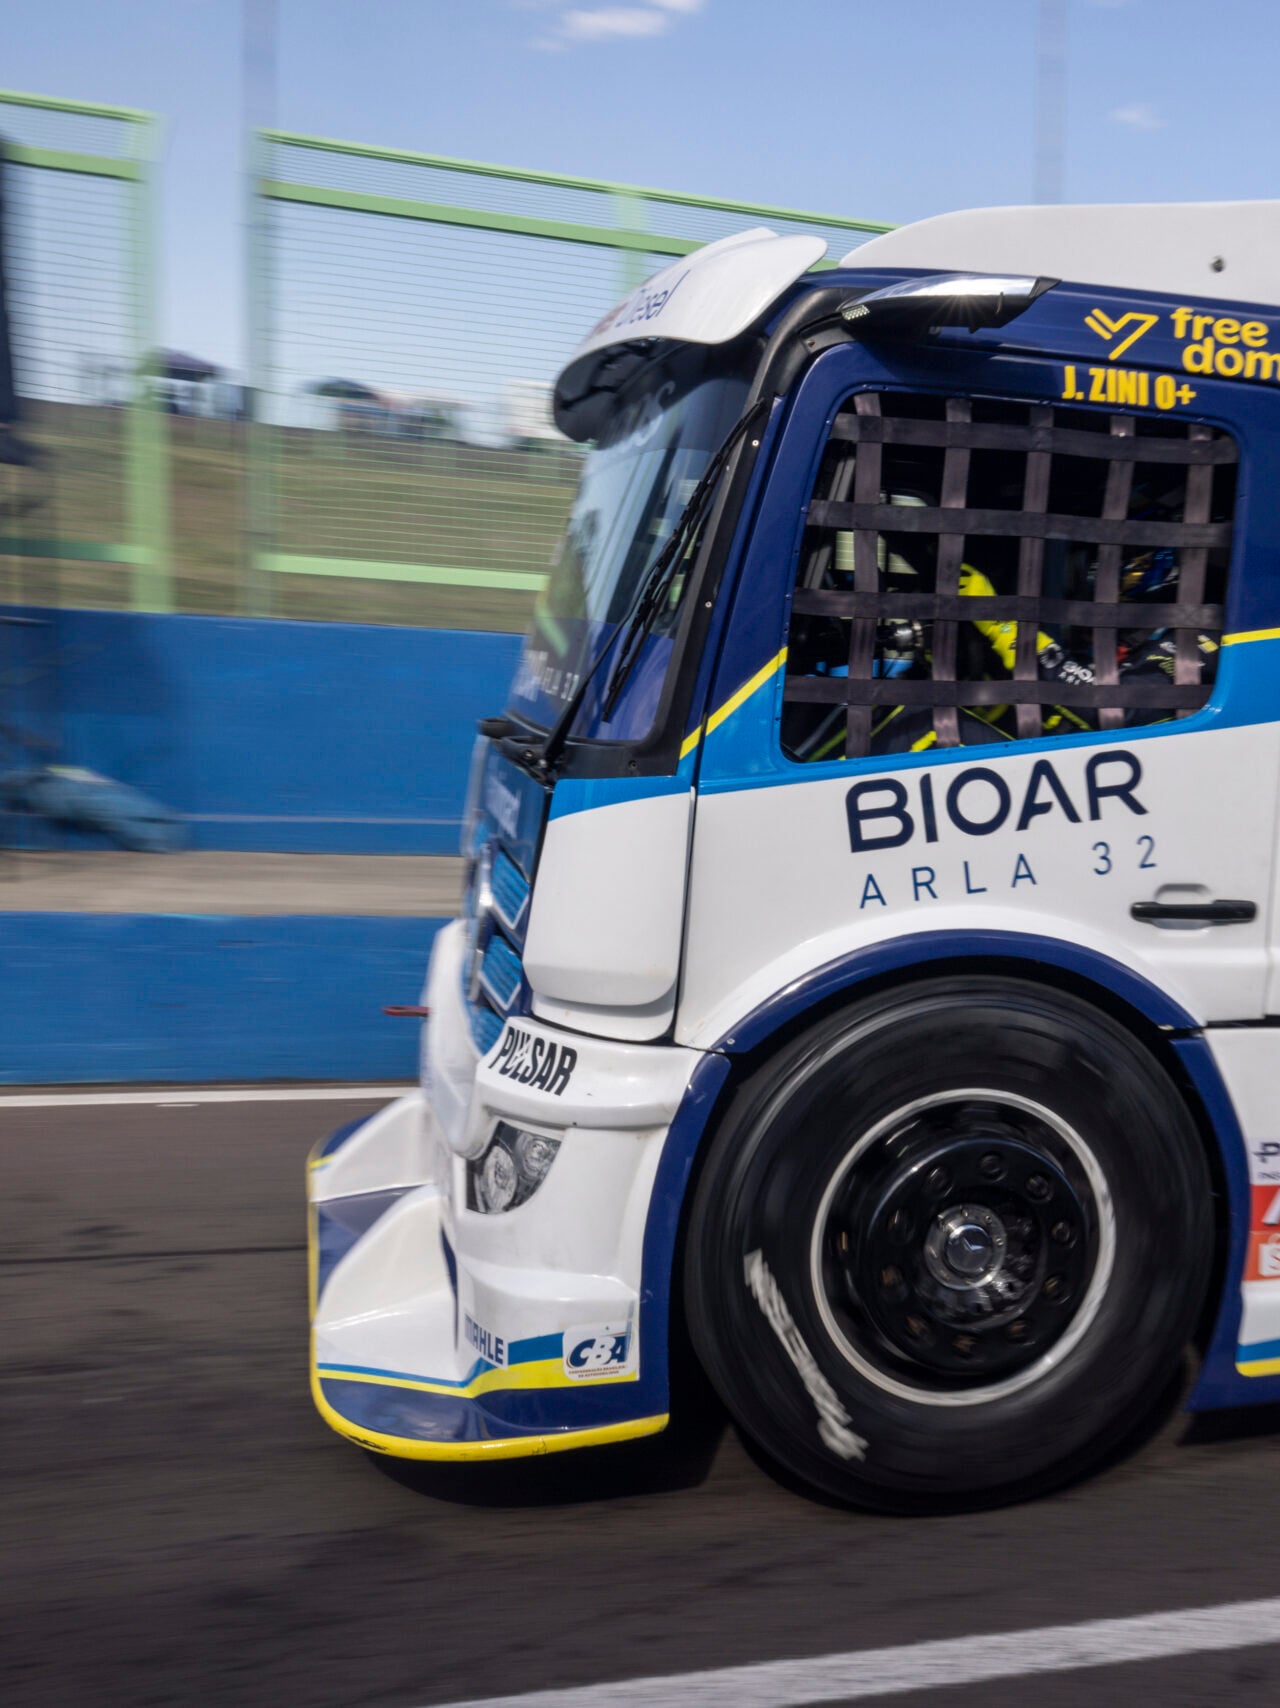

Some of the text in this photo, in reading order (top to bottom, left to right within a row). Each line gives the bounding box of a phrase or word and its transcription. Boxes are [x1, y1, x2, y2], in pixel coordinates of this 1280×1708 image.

[1170, 307, 1269, 347] free
[1061, 364, 1084, 400] J.
[1088, 366, 1150, 406] ZINI
[845, 749, 1149, 853] BIOAR
[859, 835, 1157, 909] ARLA 32
[488, 1026, 578, 1096] PULSAR
[569, 1335, 630, 1367] CBA
